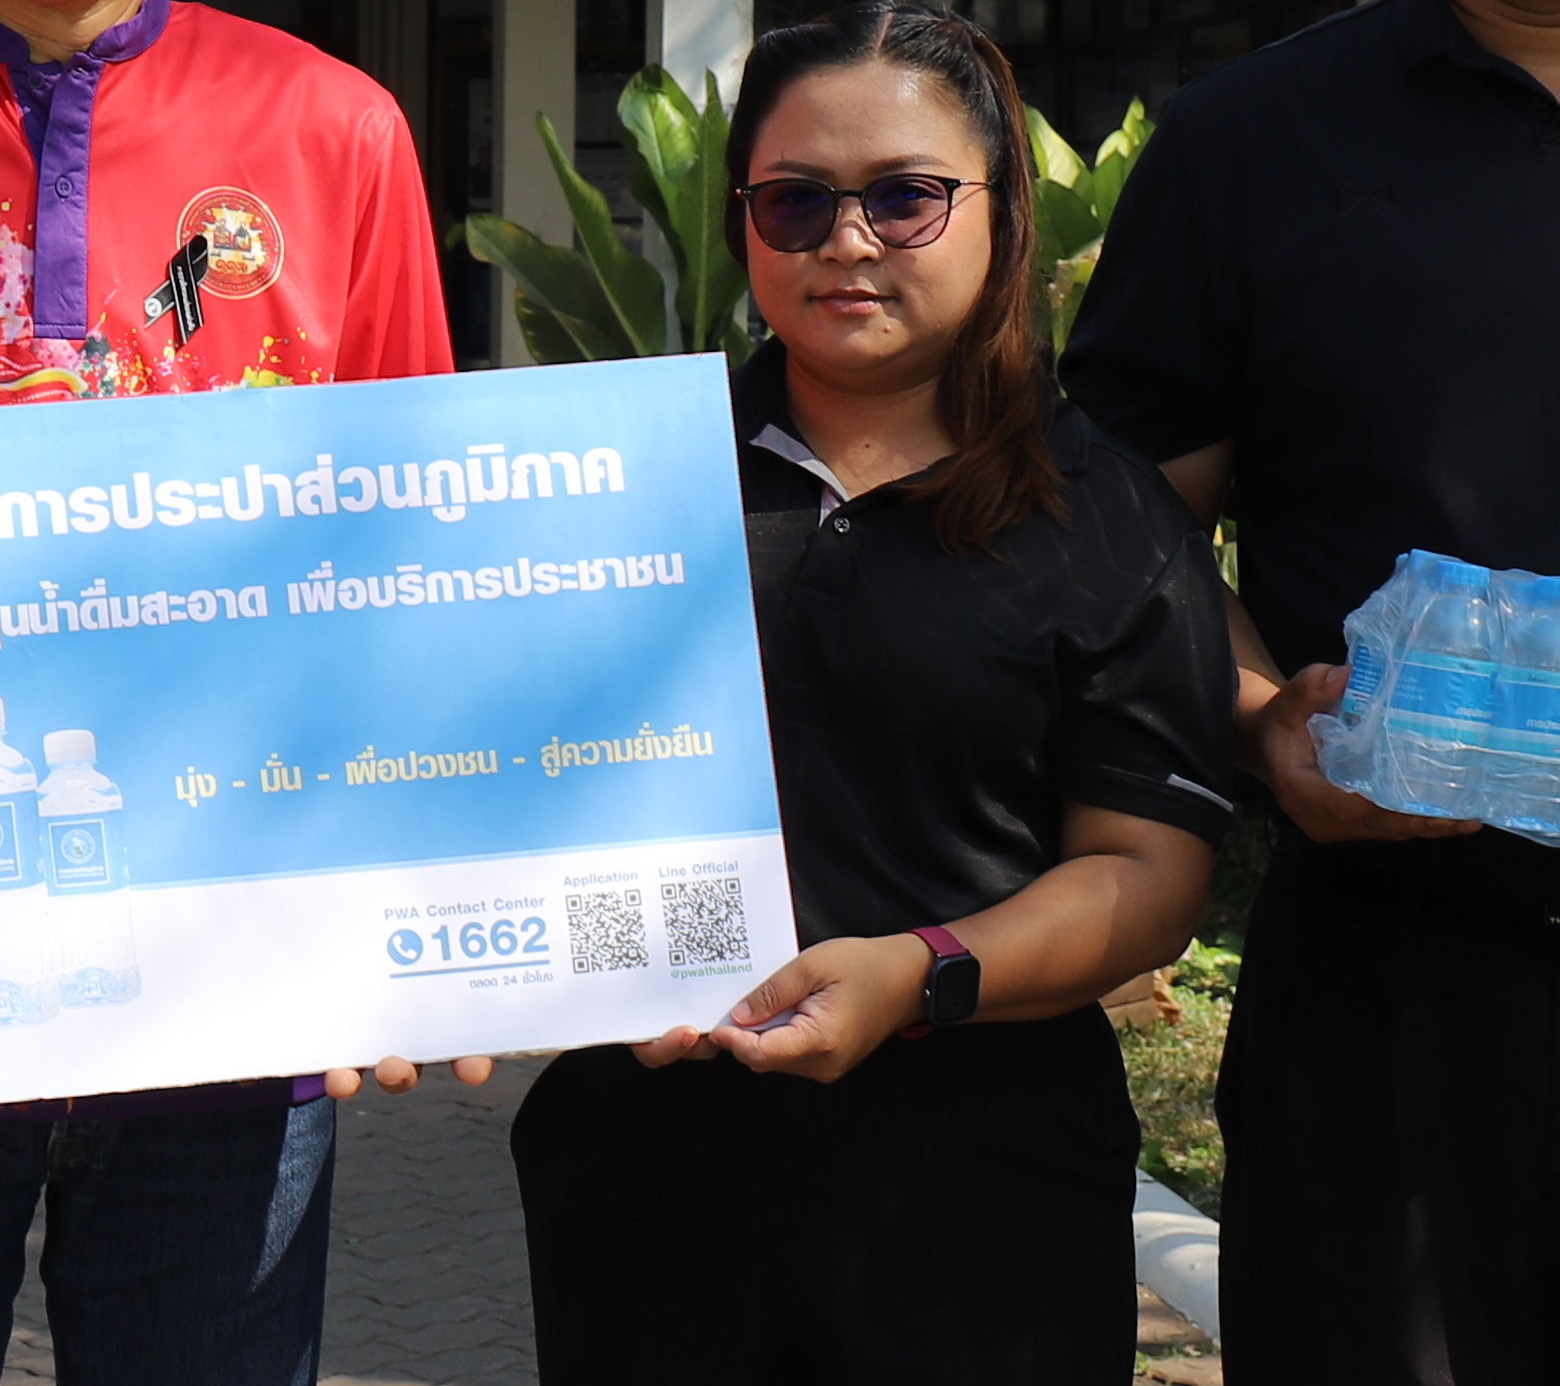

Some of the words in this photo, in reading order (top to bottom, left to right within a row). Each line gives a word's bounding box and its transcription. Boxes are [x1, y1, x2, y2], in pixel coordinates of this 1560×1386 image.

[287, 552, 685, 615] เพื่อบริการประชาชน
[175, 766, 218, 808] มุ่ง
[260, 752, 303, 793] มั่น
[345, 745, 498, 786] เพื่อปวงชน
[540, 722, 714, 779] สู่ความยั่งยืน
[563, 870, 638, 888] Application
[659, 866, 687, 878] Line
[692, 860, 739, 875] Official
[384, 906, 421, 921] PWA
[426, 900, 487, 918] Contact
[493, 896, 546, 912] Center
[431, 916, 550, 961] 1662
[502, 974, 518, 986] 24
[670, 961, 753, 981] @pwathailand
